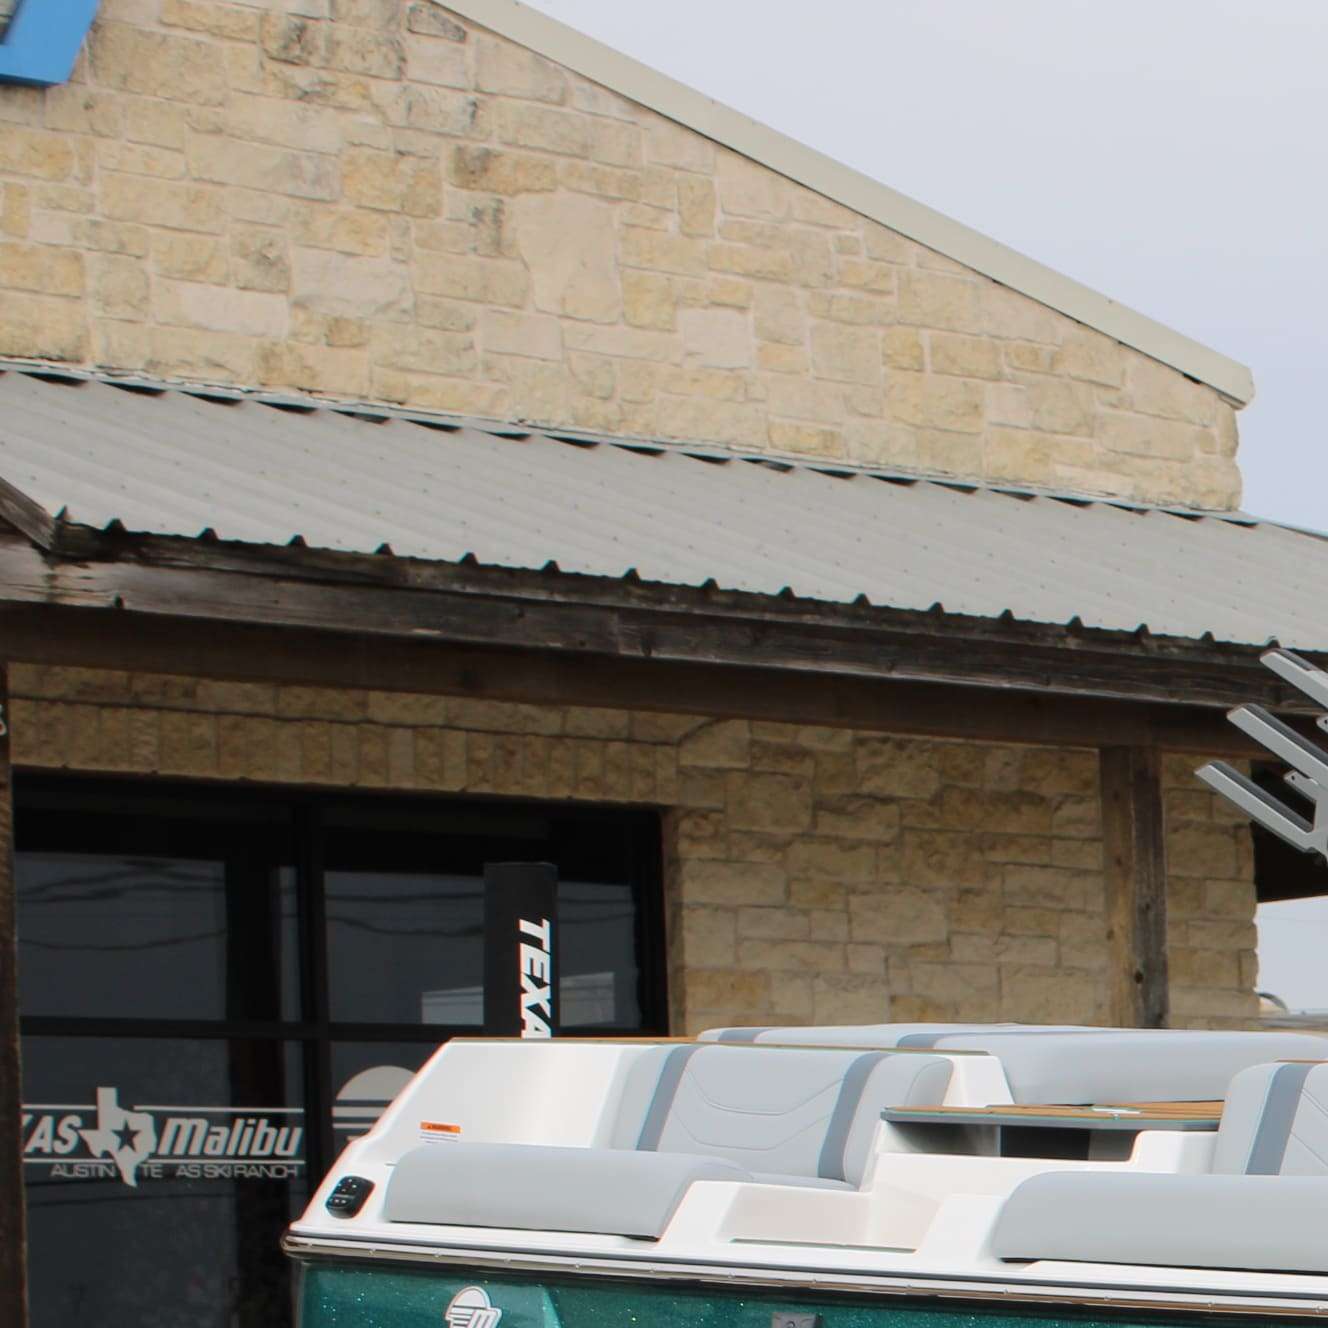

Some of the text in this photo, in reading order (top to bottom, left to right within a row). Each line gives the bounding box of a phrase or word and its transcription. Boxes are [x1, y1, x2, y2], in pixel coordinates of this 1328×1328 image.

[519, 918, 552, 1039] TEXA
[157, 1117, 303, 1156] Malibu
[50, 1163, 115, 1178] AUSTIN
